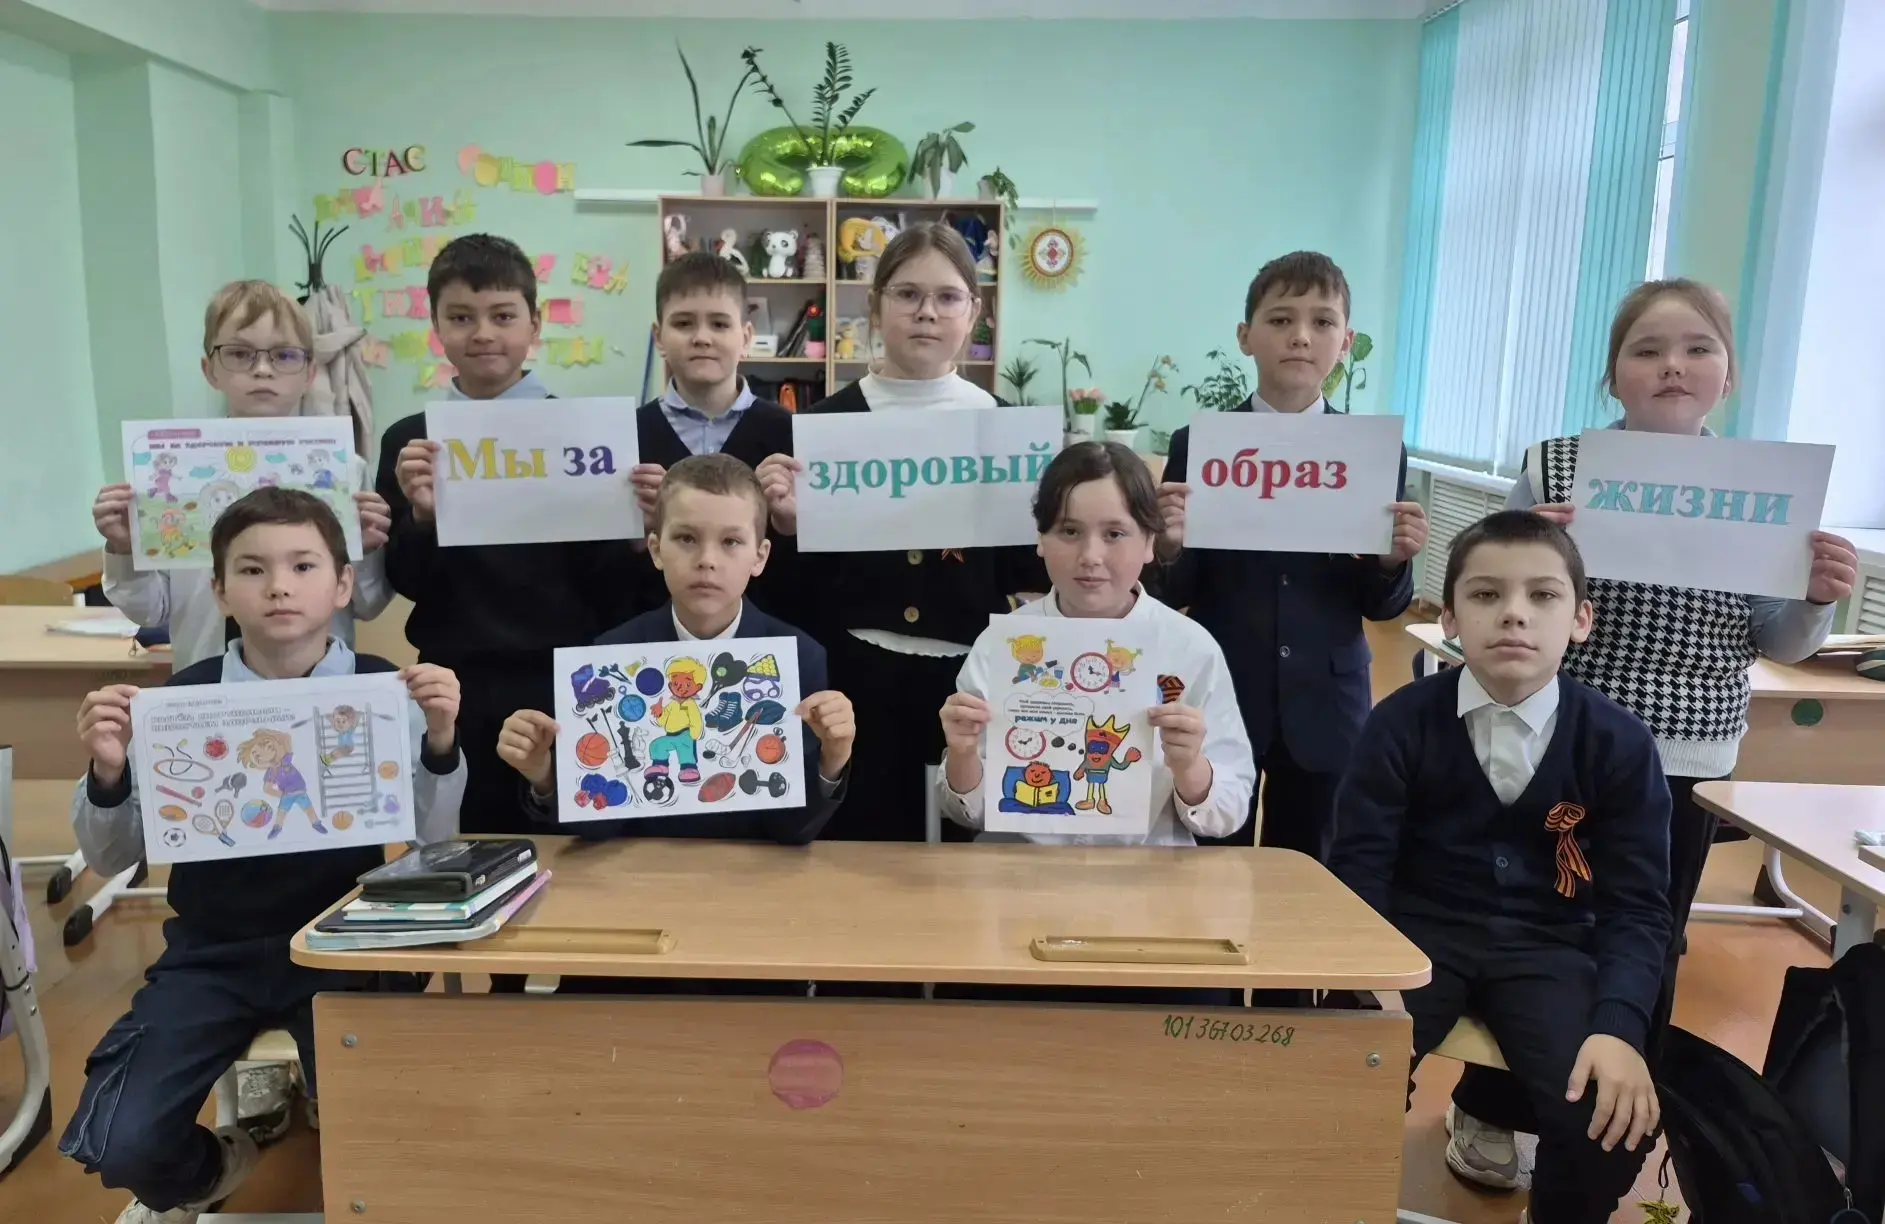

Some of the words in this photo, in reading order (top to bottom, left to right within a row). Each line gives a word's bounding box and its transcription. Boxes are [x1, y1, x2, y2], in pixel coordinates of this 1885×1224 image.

[443, 437, 549, 481] Мы
[563, 445, 616, 476] за
[808, 441, 1056, 498] здоровый
[1201, 448, 1347, 499] образ
[1584, 478, 1794, 526] жизни
